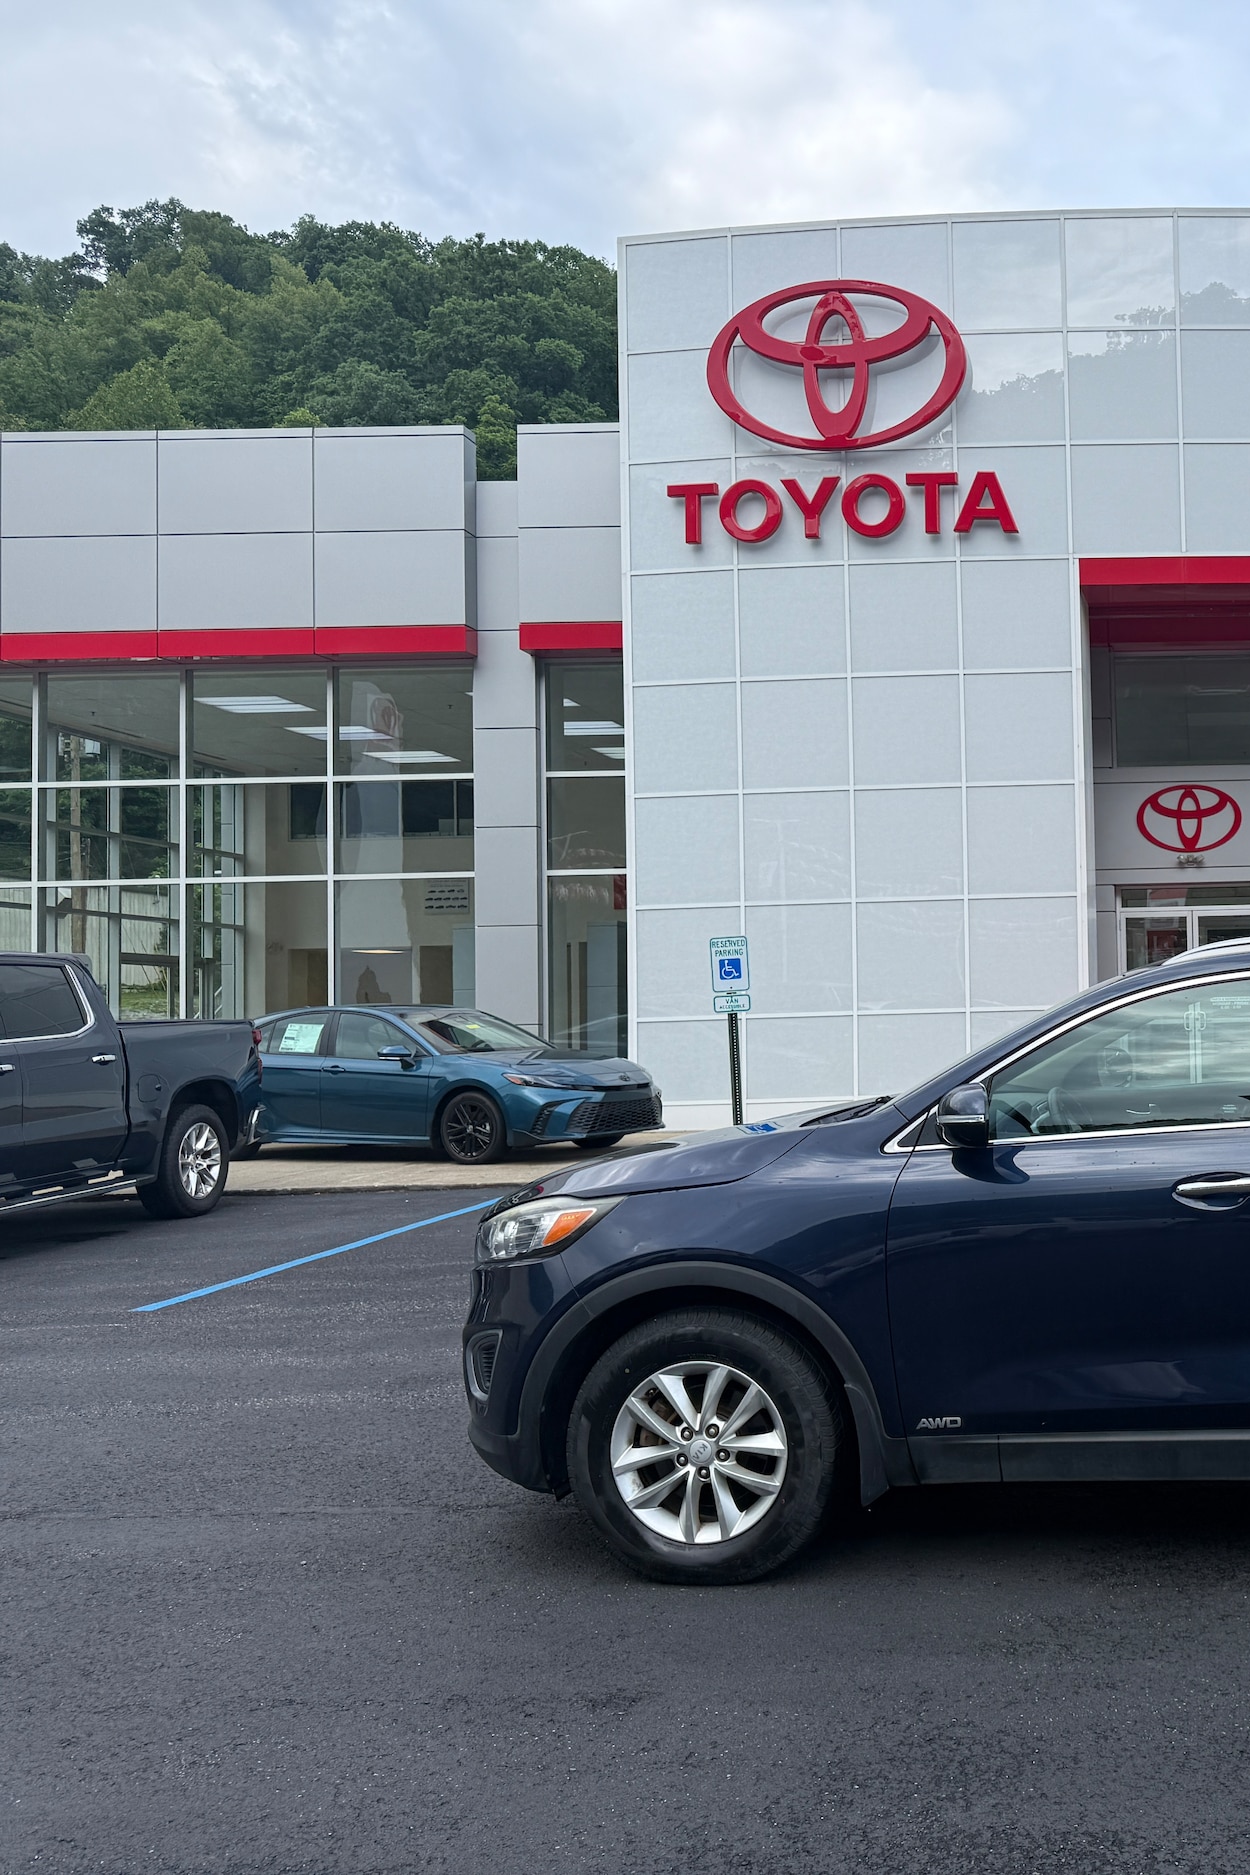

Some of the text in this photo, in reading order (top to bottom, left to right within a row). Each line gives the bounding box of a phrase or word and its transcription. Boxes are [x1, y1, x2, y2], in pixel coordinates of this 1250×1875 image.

[667, 471, 1020, 545] TOYOTA
[711, 939, 746, 949] RESERVED
[714, 948, 744, 957] PARKING
[916, 1416, 962, 1430] AWD
[692, 1443, 708, 1460] KIA
